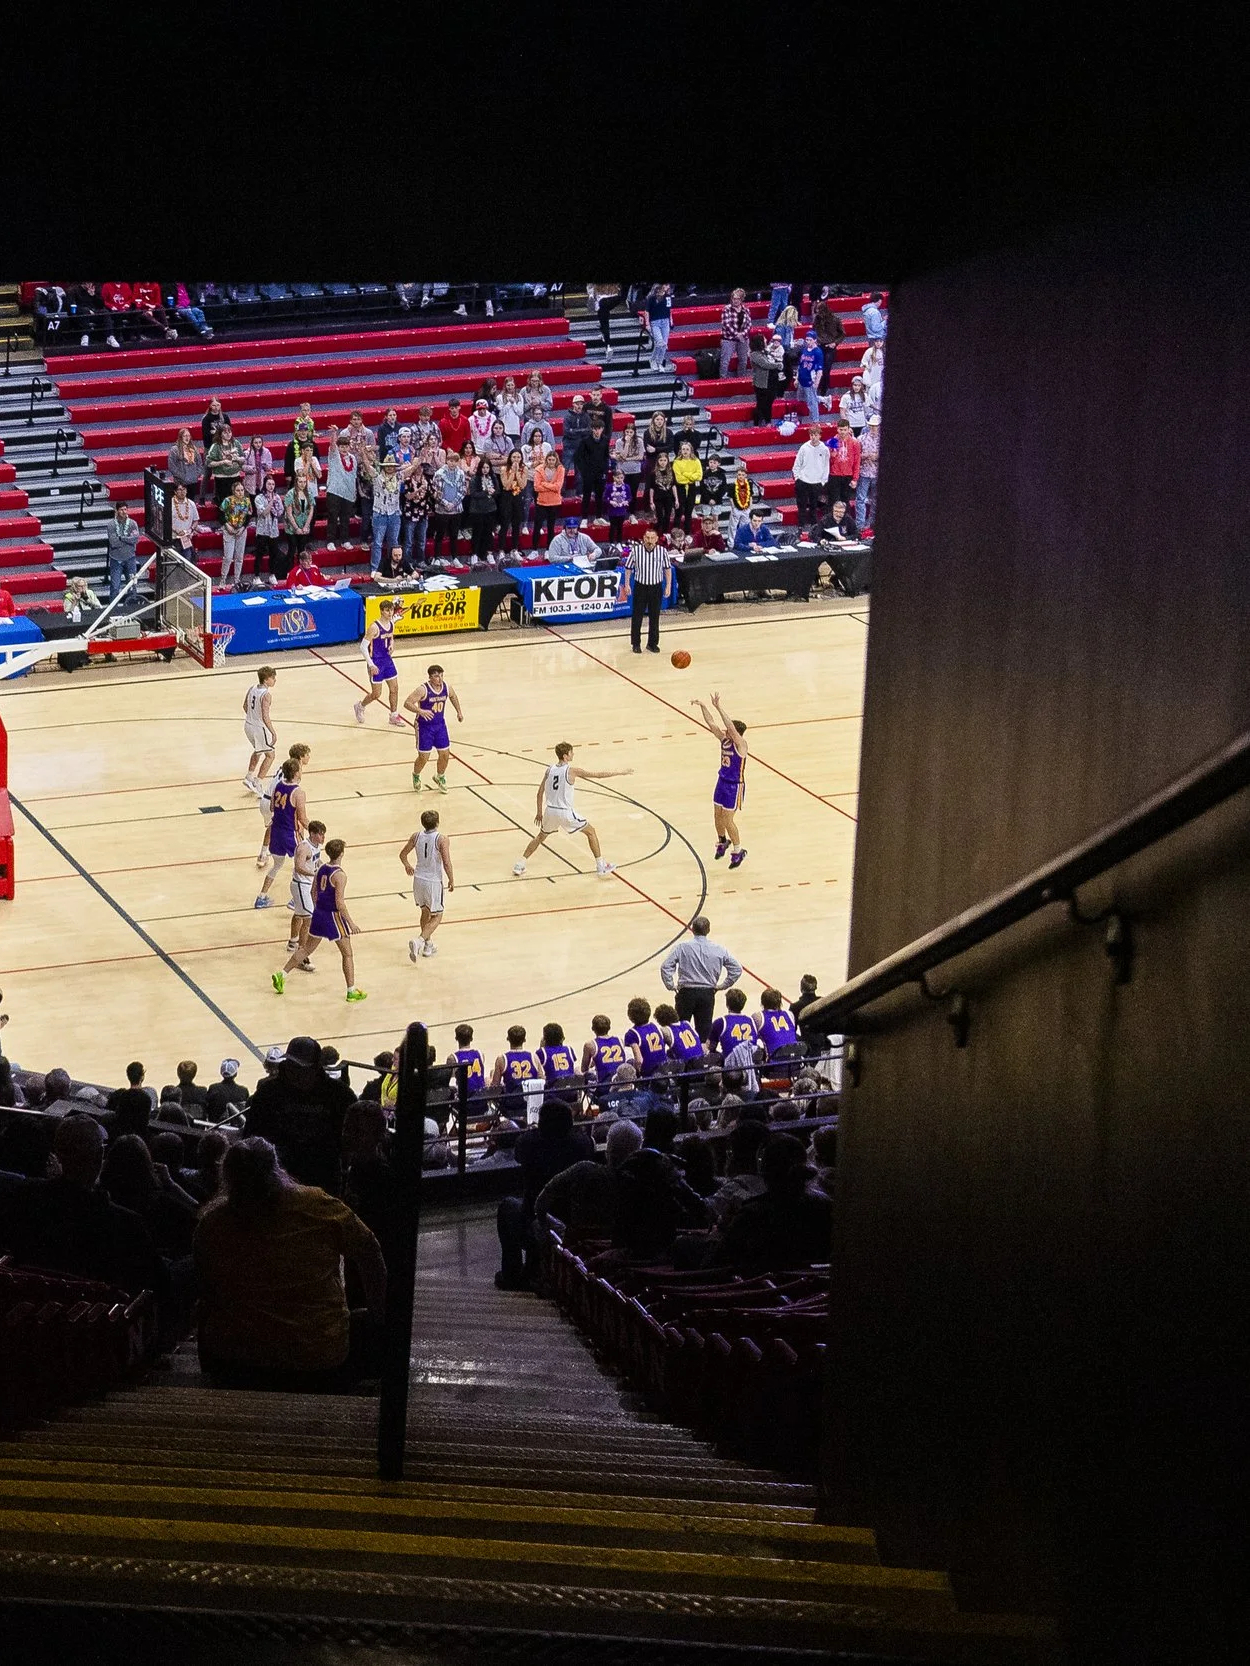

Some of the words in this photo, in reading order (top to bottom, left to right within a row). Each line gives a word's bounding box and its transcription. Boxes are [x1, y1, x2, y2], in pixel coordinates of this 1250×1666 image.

[550, 282, 563, 292] A7
[47, 320, 61, 331] A7
[445, 590, 466, 602] 92.3
[534, 575, 618, 603] KFOR
[410, 601, 467, 620] KBEAR
[534, 606, 547, 615] FM
[549, 604, 572, 614] 103.3
[581, 601, 601, 611] 1240
[431, 701, 444, 713] 40
[552, 775, 559, 791] 2
[274, 791, 288, 809] 24
[320, 875, 327, 891] 0
[730, 1023, 754, 1041] 42
[770, 1015, 790, 1032] 14
[646, 1032, 663, 1052] 12
[679, 1029, 697, 1049] 10
[551, 1052, 568, 1071] 15
[600, 1045, 624, 1063] 22
[510, 1060, 532, 1079] 32
